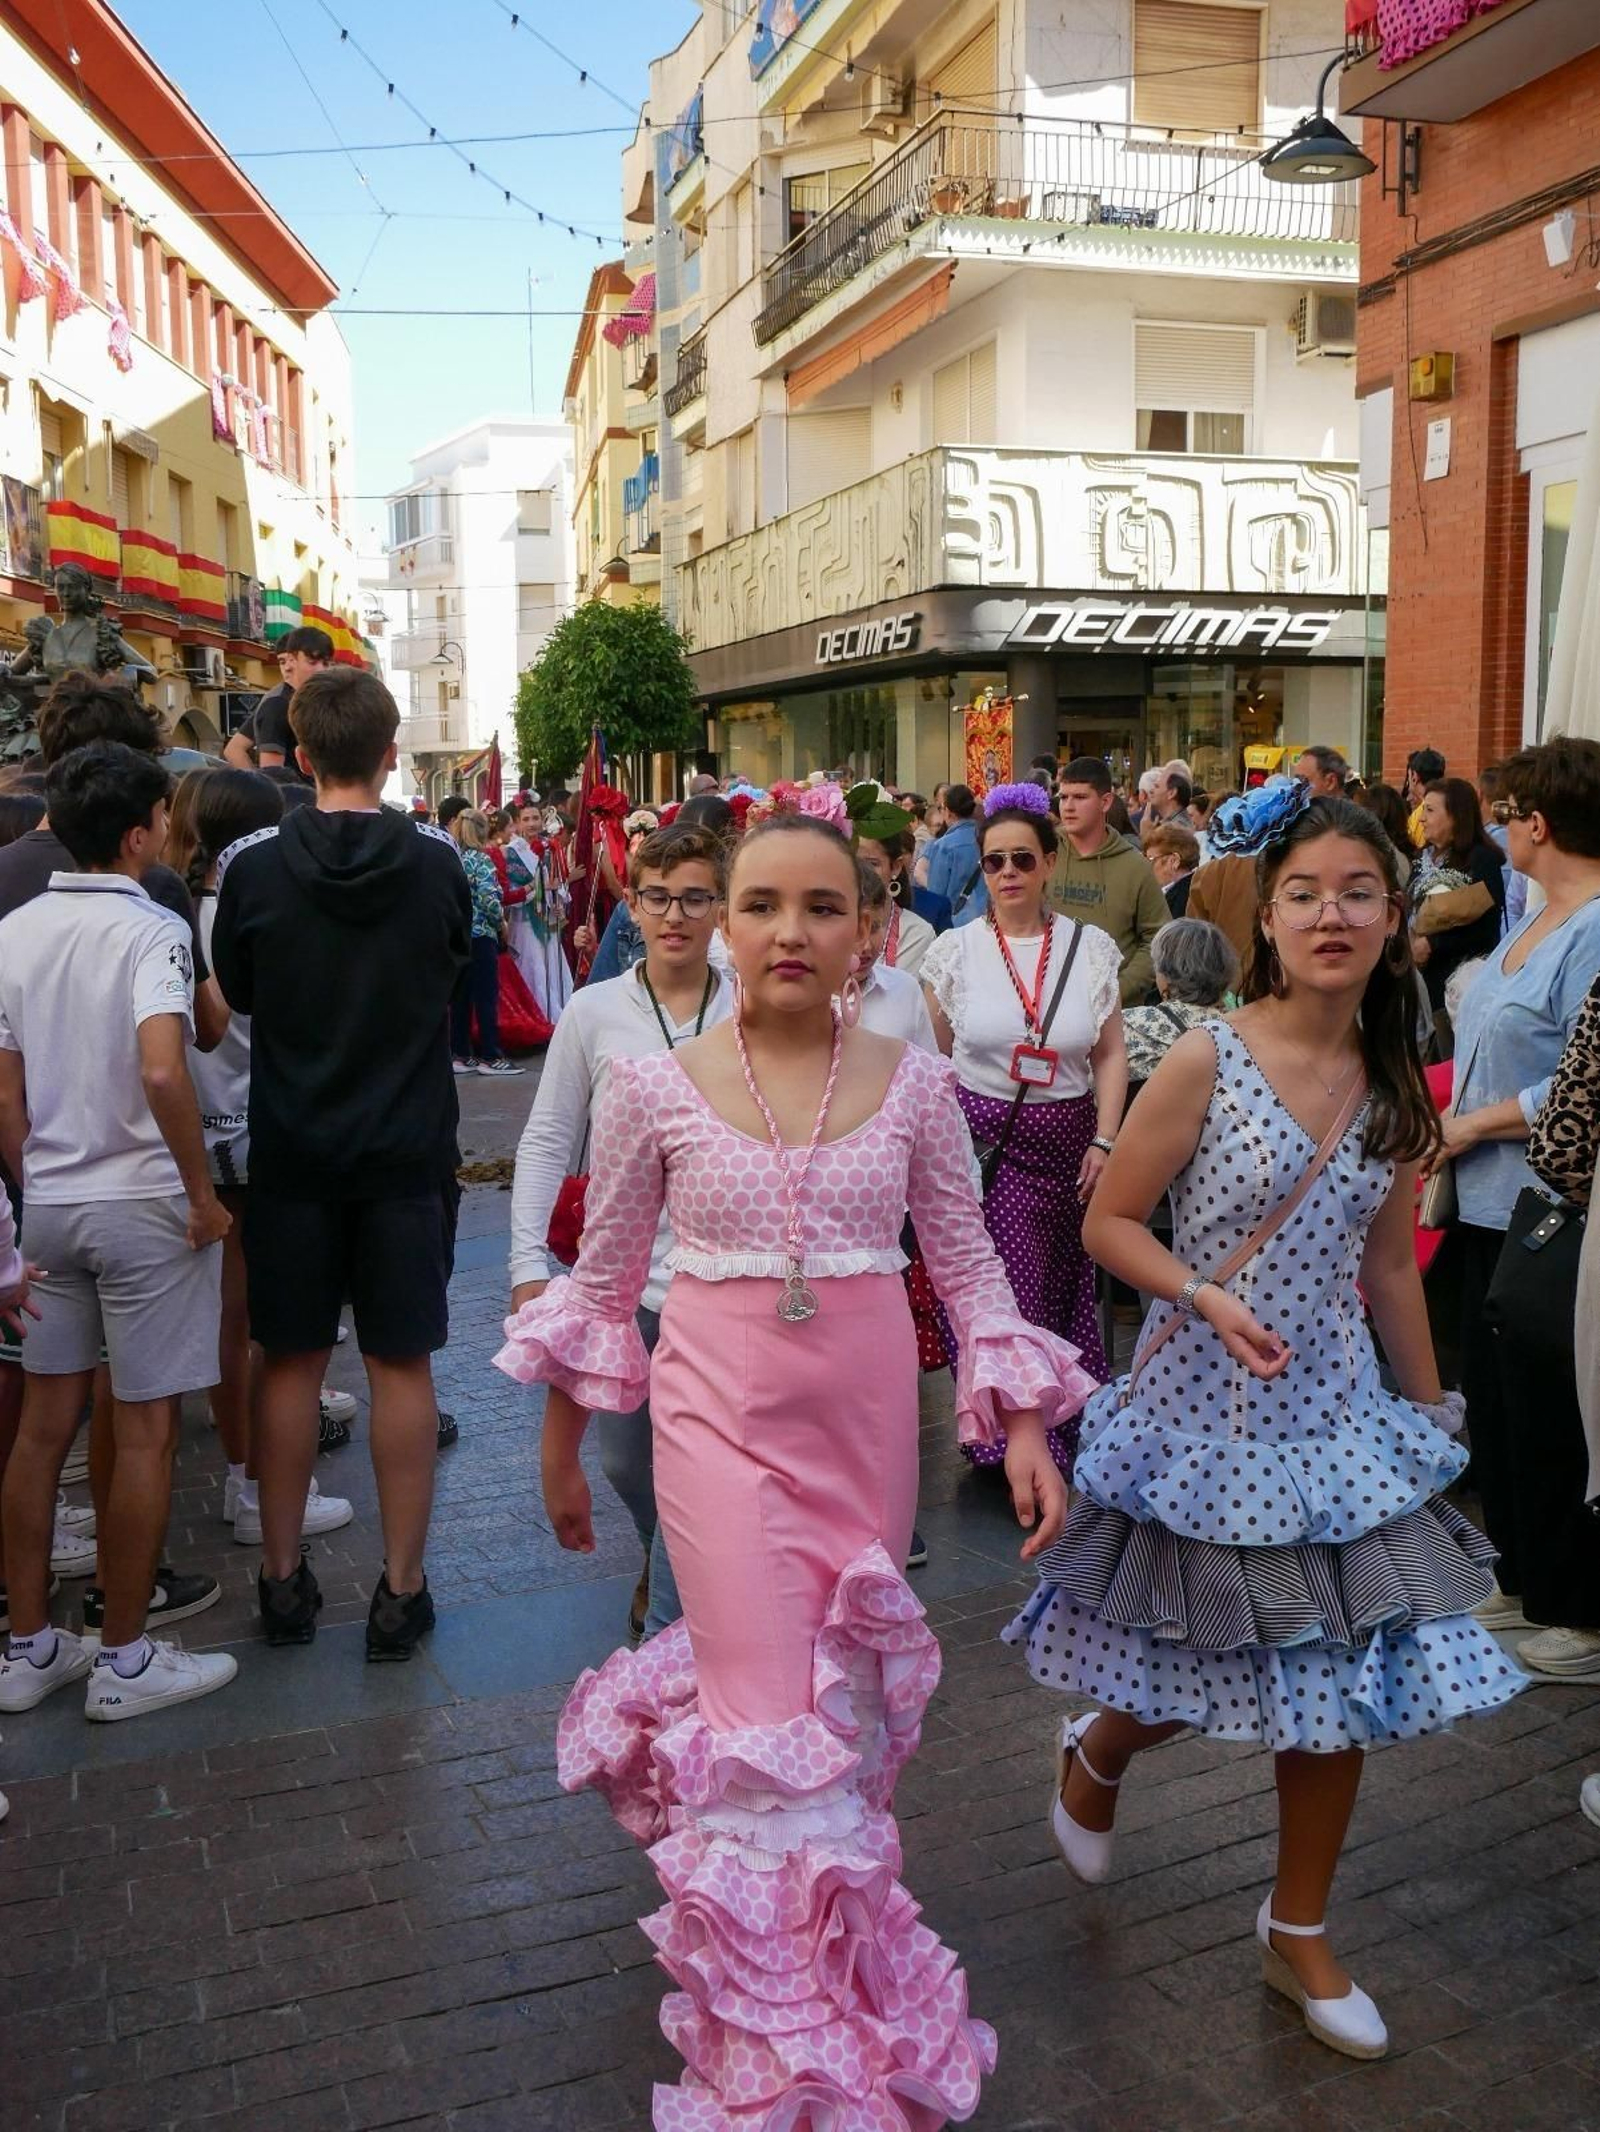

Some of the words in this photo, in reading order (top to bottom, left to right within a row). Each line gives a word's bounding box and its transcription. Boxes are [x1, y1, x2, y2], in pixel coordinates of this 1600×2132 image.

[815, 612, 915, 664] DECIMAS
[1006, 606, 1341, 647] DECIMAS
[99, 1696, 122, 1705] FILA
